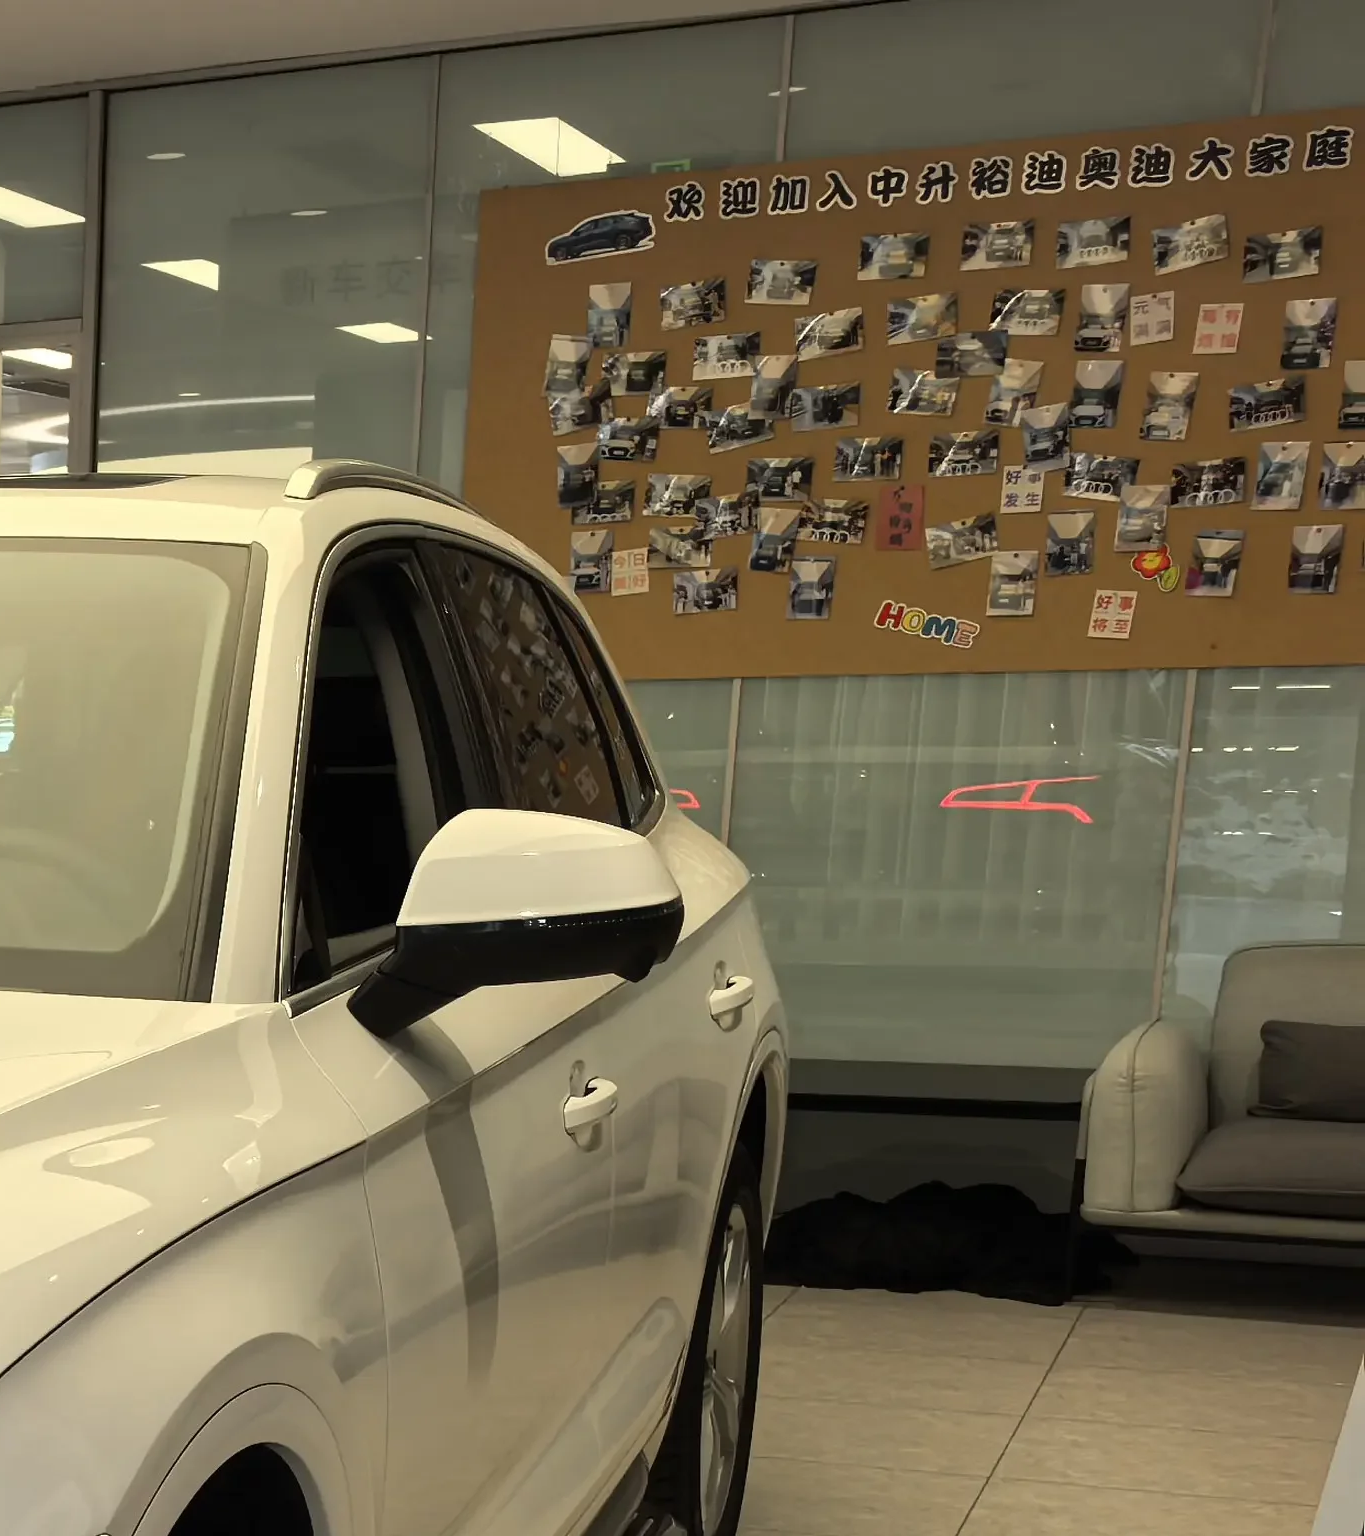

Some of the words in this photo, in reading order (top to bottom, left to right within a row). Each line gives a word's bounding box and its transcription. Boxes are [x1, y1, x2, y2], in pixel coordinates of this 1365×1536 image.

[666, 128, 1352, 218] 欢迎加入中升裕迪奥迪大家庭
[875, 601, 979, 648] HOME
